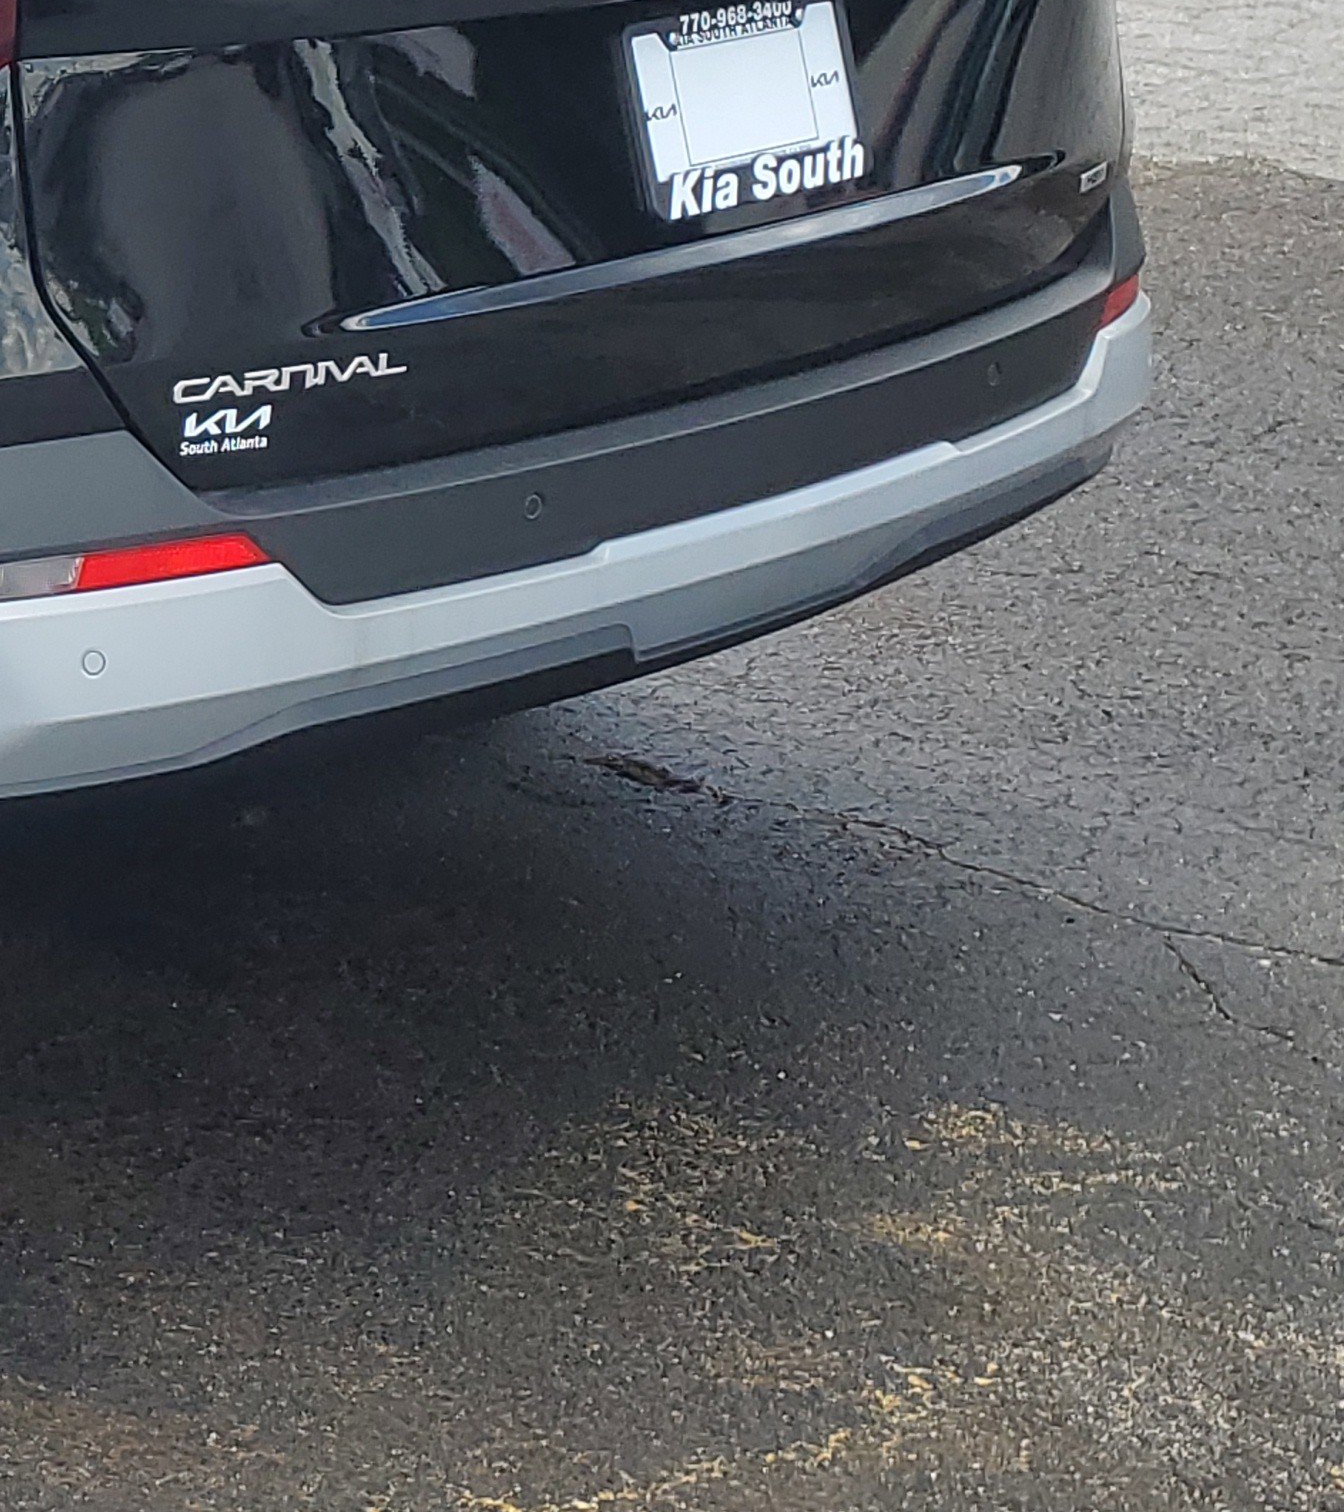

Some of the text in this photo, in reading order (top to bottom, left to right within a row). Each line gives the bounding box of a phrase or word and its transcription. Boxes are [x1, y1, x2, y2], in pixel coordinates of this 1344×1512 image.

[811, 70, 839, 88] KIA
[670, 168, 739, 220] Kia
[752, 136, 865, 201] South
[173, 352, 408, 404] CARNIVAL
[183, 404, 272, 438] KIA
[179, 435, 268, 456] South Atlanta
